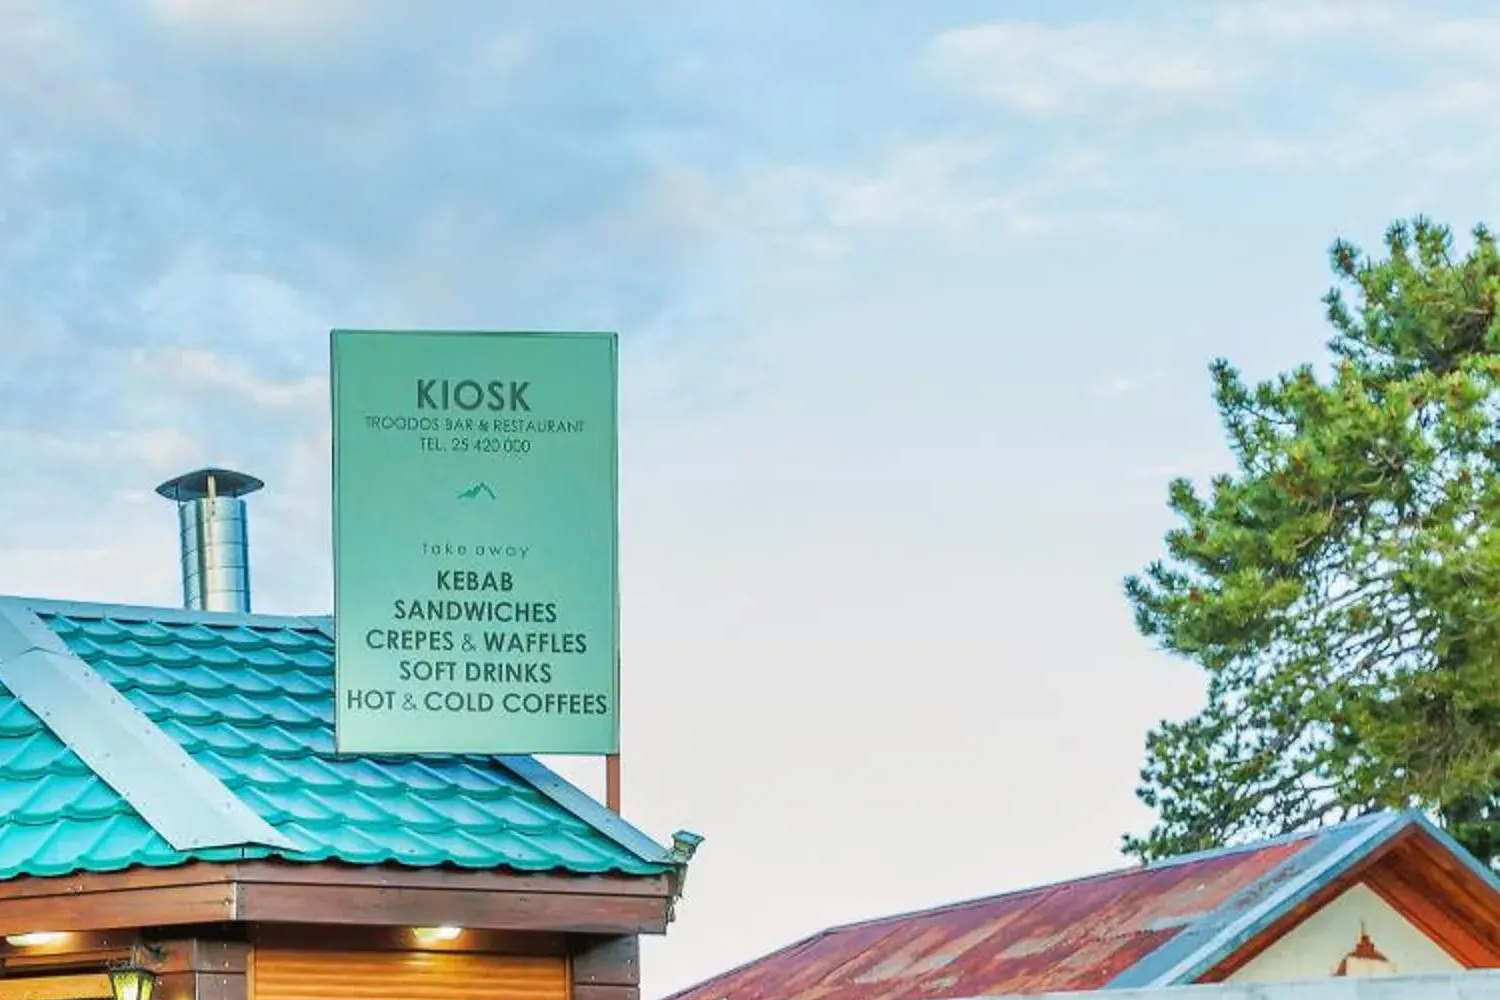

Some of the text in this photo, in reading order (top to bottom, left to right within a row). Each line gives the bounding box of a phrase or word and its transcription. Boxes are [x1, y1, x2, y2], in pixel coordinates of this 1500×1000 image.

[416, 378, 532, 412] KIOSK
[365, 415, 585, 433] TROODOS BAR & RESTAURANT
[420, 437, 447, 451] TEL.
[451, 438, 468, 451] 25
[474, 439, 500, 453] 420
[422, 543, 529, 559] take away
[436, 570, 514, 592] KEBAB
[393, 599, 557, 623] SANDWICHES
[365, 629, 587, 653] CREPES & WAFFLES
[399, 660, 552, 683] SOFT DRINKS
[347, 690, 608, 714] HOT & COLD COFFEES
